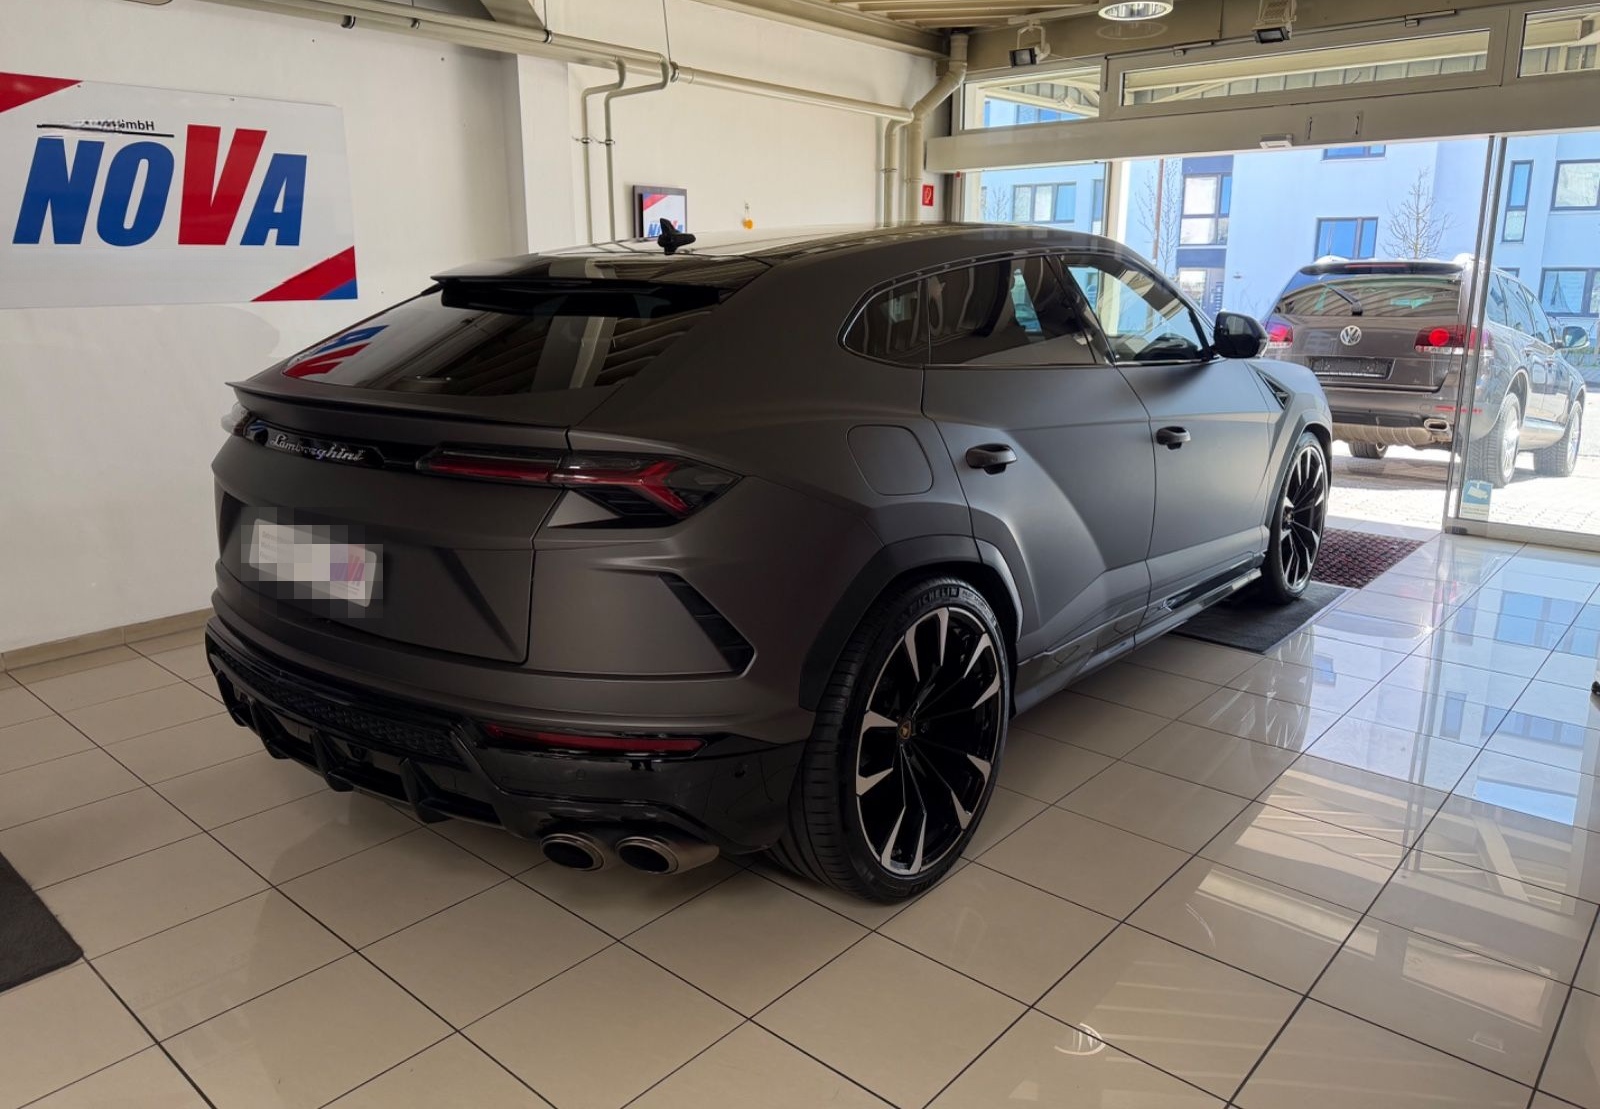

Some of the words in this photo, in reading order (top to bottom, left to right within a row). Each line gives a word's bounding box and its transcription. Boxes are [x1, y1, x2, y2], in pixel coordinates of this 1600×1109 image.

[12, 124, 307, 247] NOVA
[648, 220, 684, 237] NA
[269, 433, 365, 461] Lamborghini
